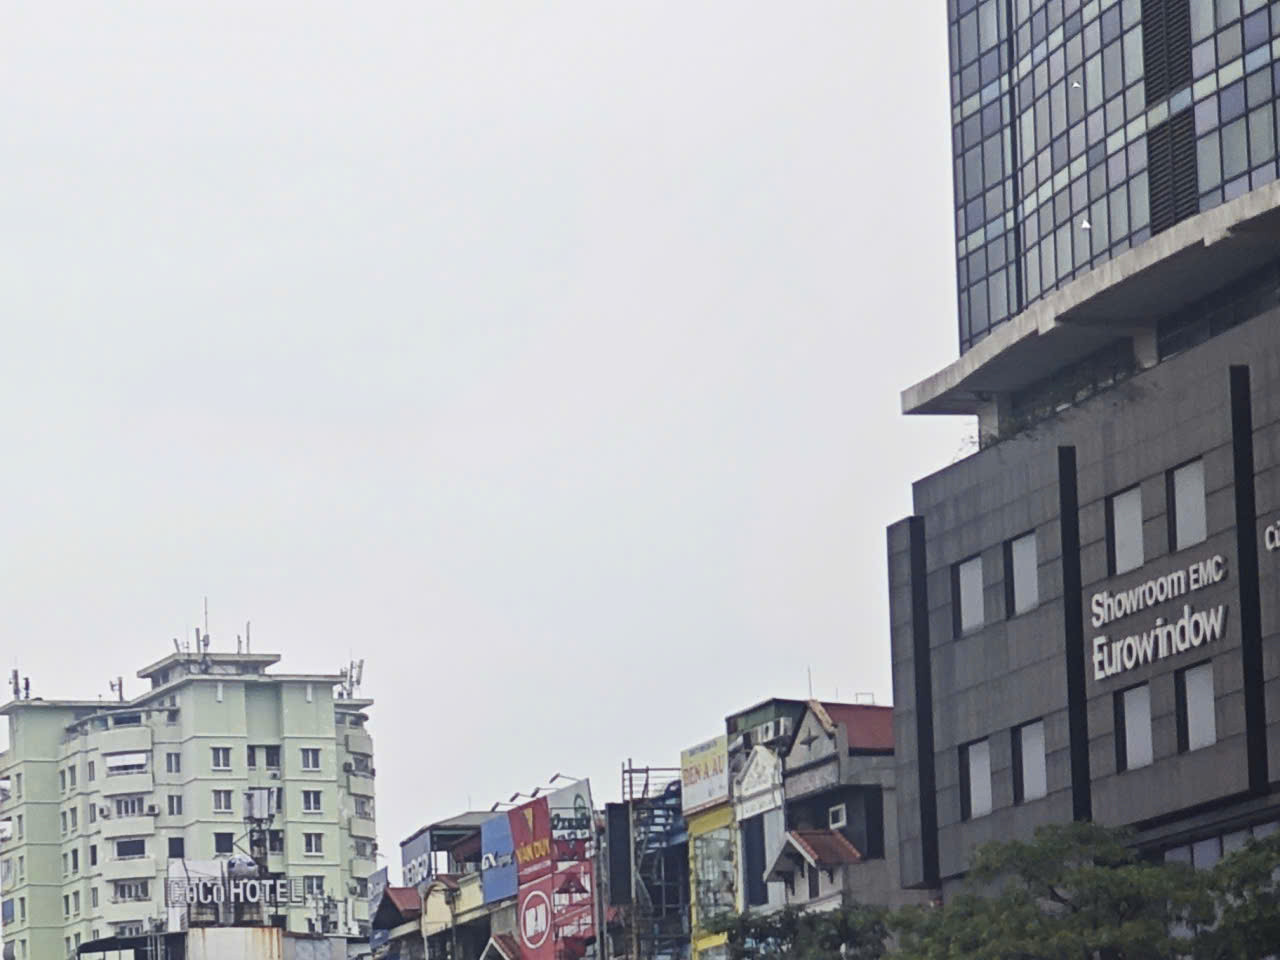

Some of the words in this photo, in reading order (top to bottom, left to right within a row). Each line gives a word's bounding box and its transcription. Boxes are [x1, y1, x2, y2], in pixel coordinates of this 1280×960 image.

[1091, 569, 1186, 628] Showroom
[1189, 554, 1224, 590] EMC
[1092, 604, 1224, 680] Eurowindow
[230, 879, 303, 903] HOTEL
